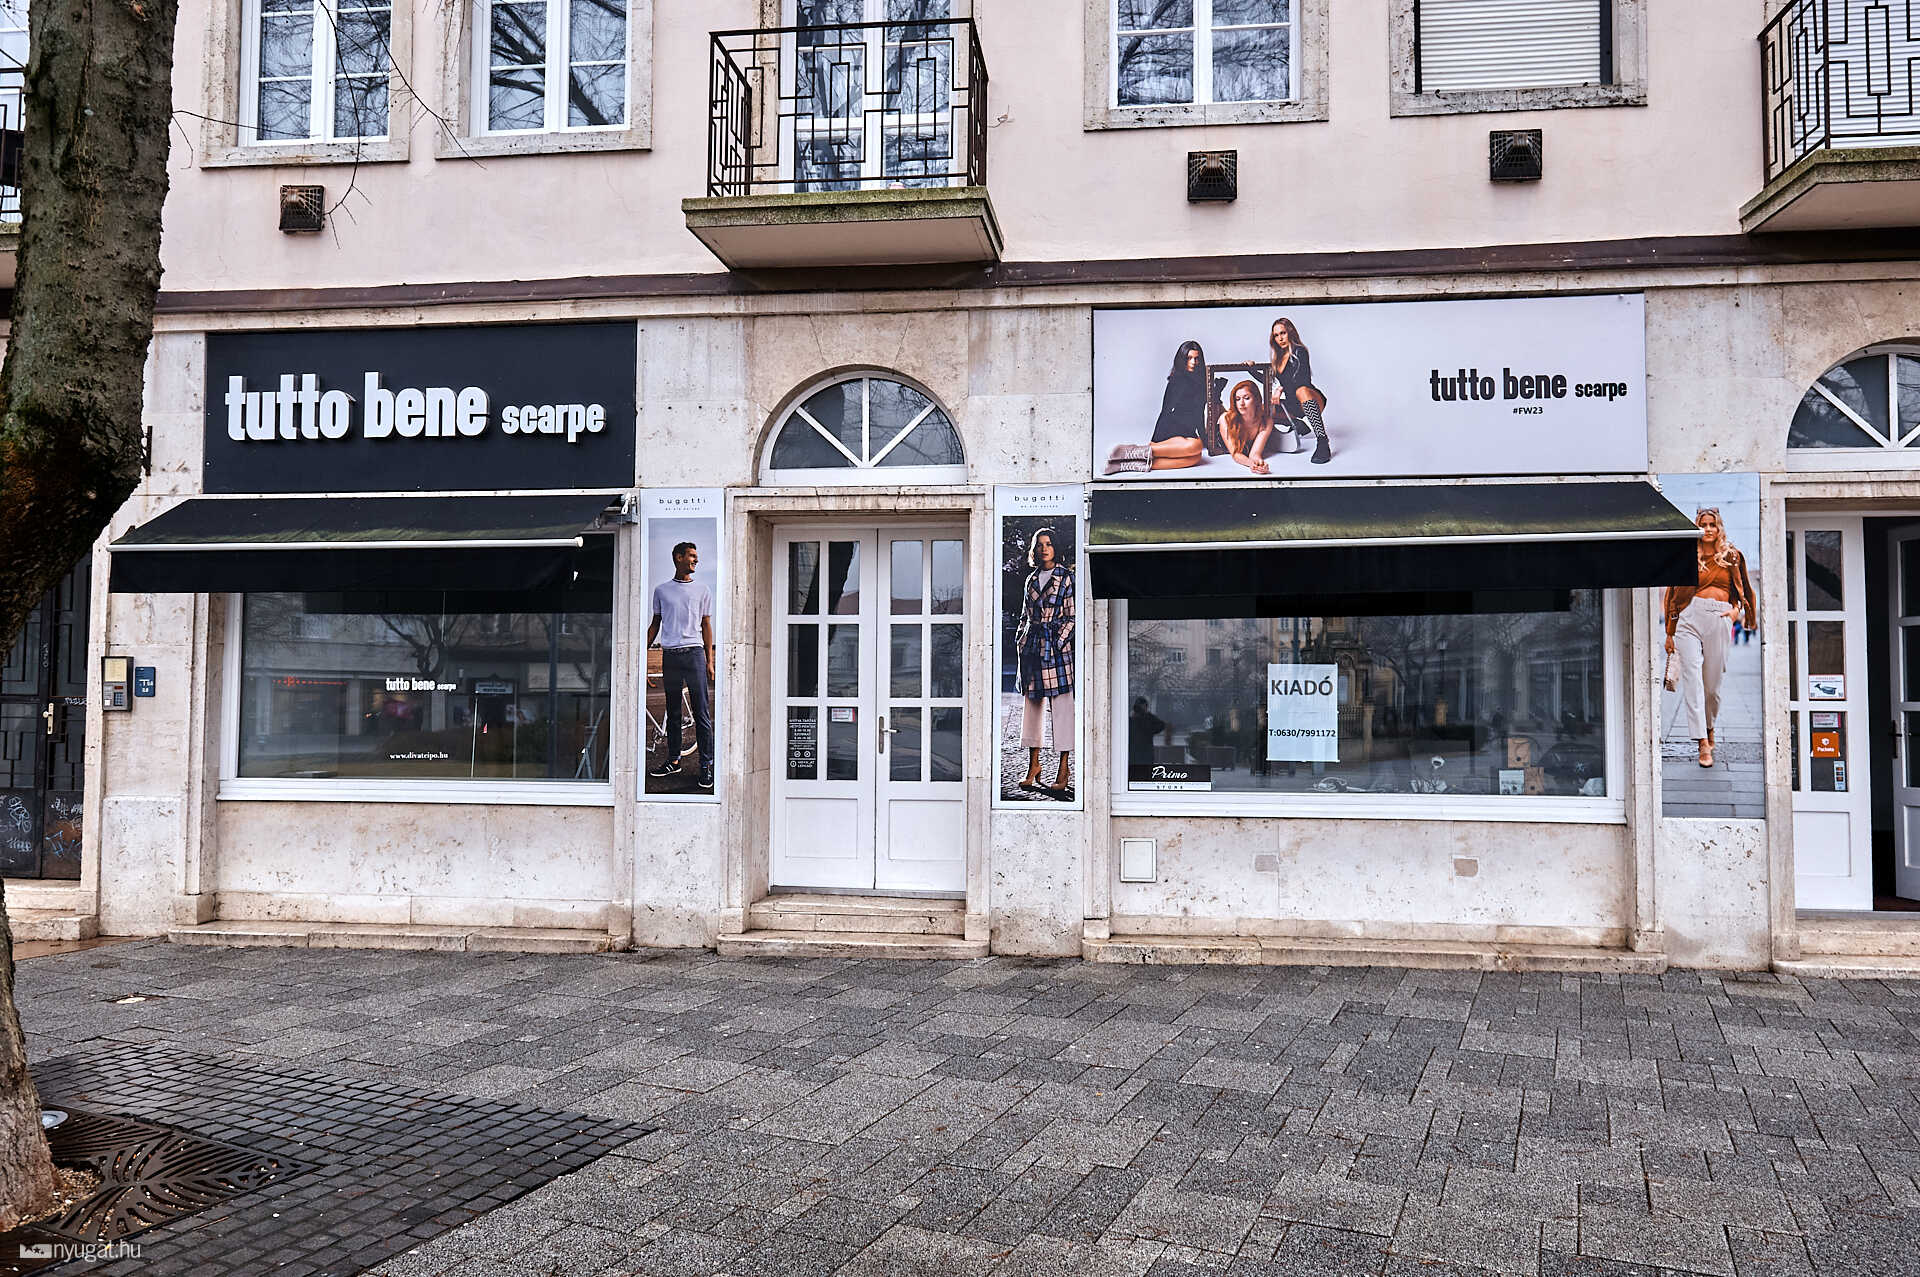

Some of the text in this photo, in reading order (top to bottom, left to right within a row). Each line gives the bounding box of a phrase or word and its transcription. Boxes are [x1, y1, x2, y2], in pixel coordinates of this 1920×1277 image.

[1430, 367, 1628, 402] tutto bene scarpe
[225, 371, 606, 443] tutto bene scarpe
[1512, 406, 1544, 415] #FW23
[386, 678, 410, 691] tutto
[411, 677, 436, 691] bene
[1271, 675, 1334, 696] KIADÓ
[1268, 728, 1337, 738] T:0630/7991172
[1151, 765, 1188, 779] Primo
